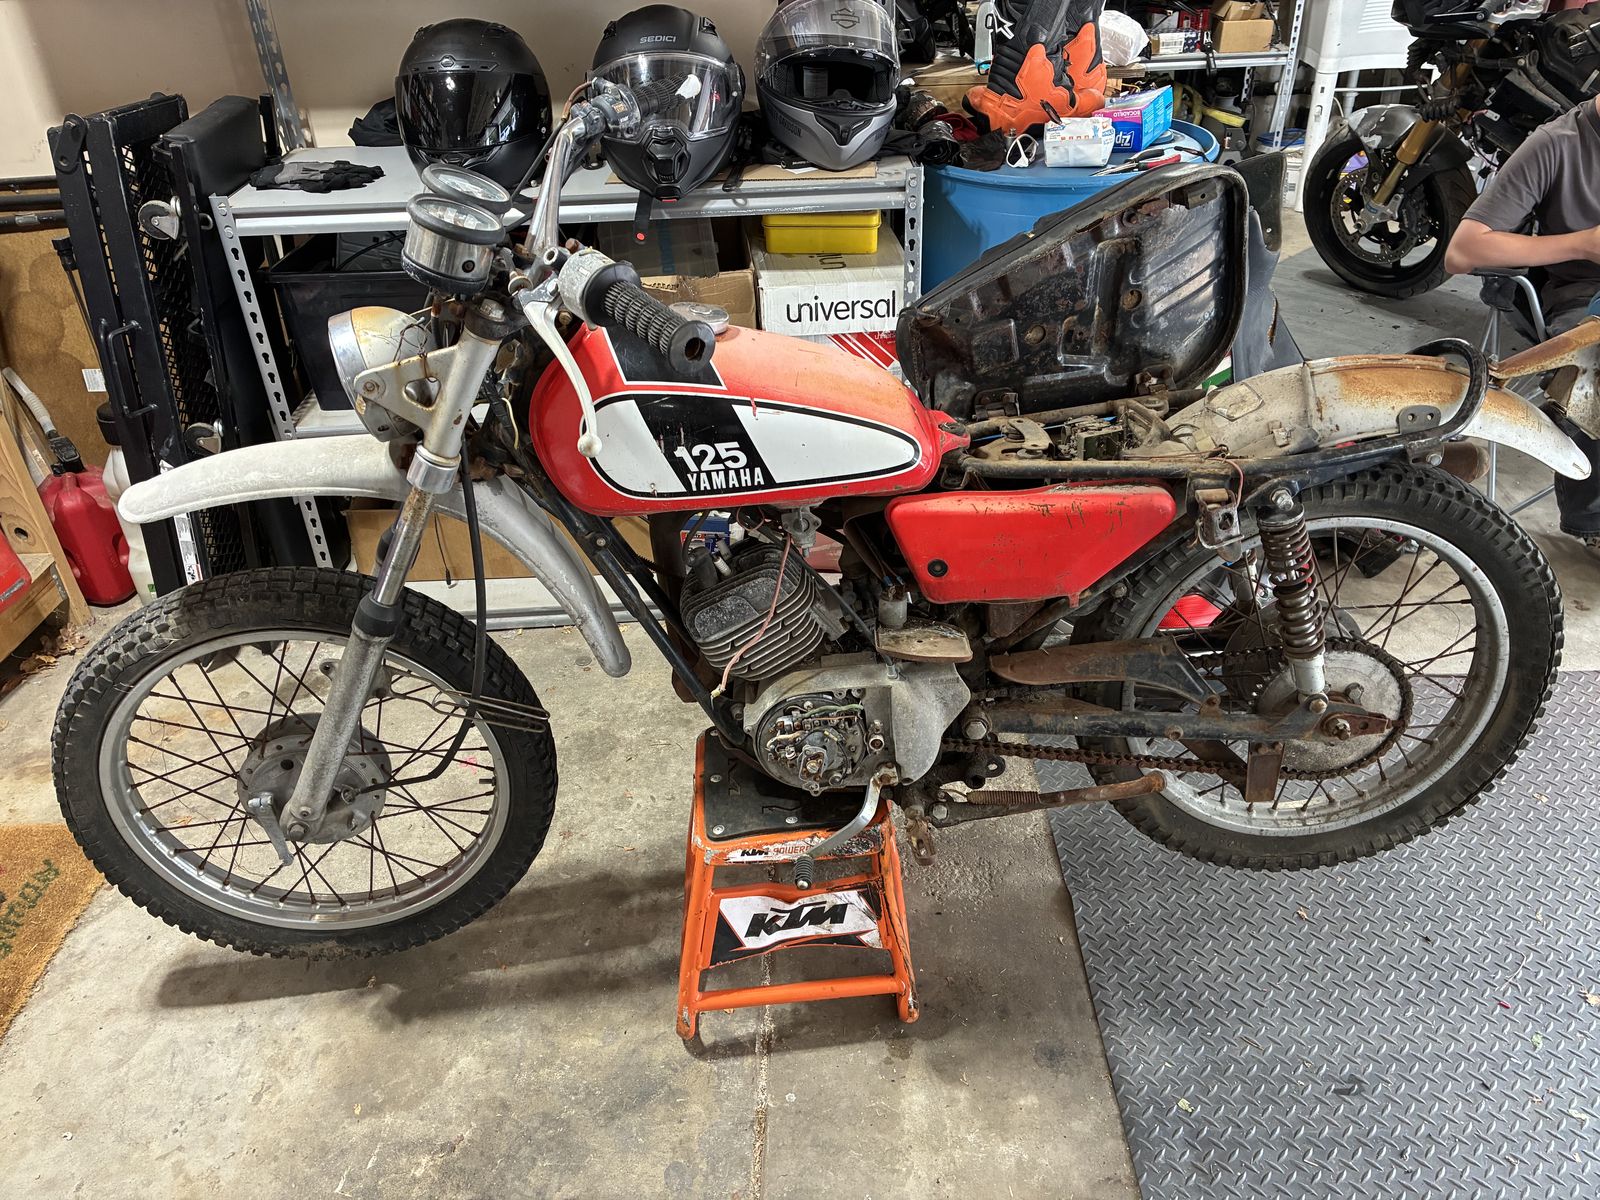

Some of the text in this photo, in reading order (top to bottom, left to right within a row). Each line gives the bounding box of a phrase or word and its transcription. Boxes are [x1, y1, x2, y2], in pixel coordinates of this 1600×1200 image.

[640, 35, 676, 43] SEDICI
[1115, 132, 1131, 147] Zip
[786, 290, 895, 323] universal
[674, 442, 747, 471] 125
[687, 467, 764, 491] YAMAHA
[741, 848, 768, 857] KTM
[744, 901, 848, 938] KTM
